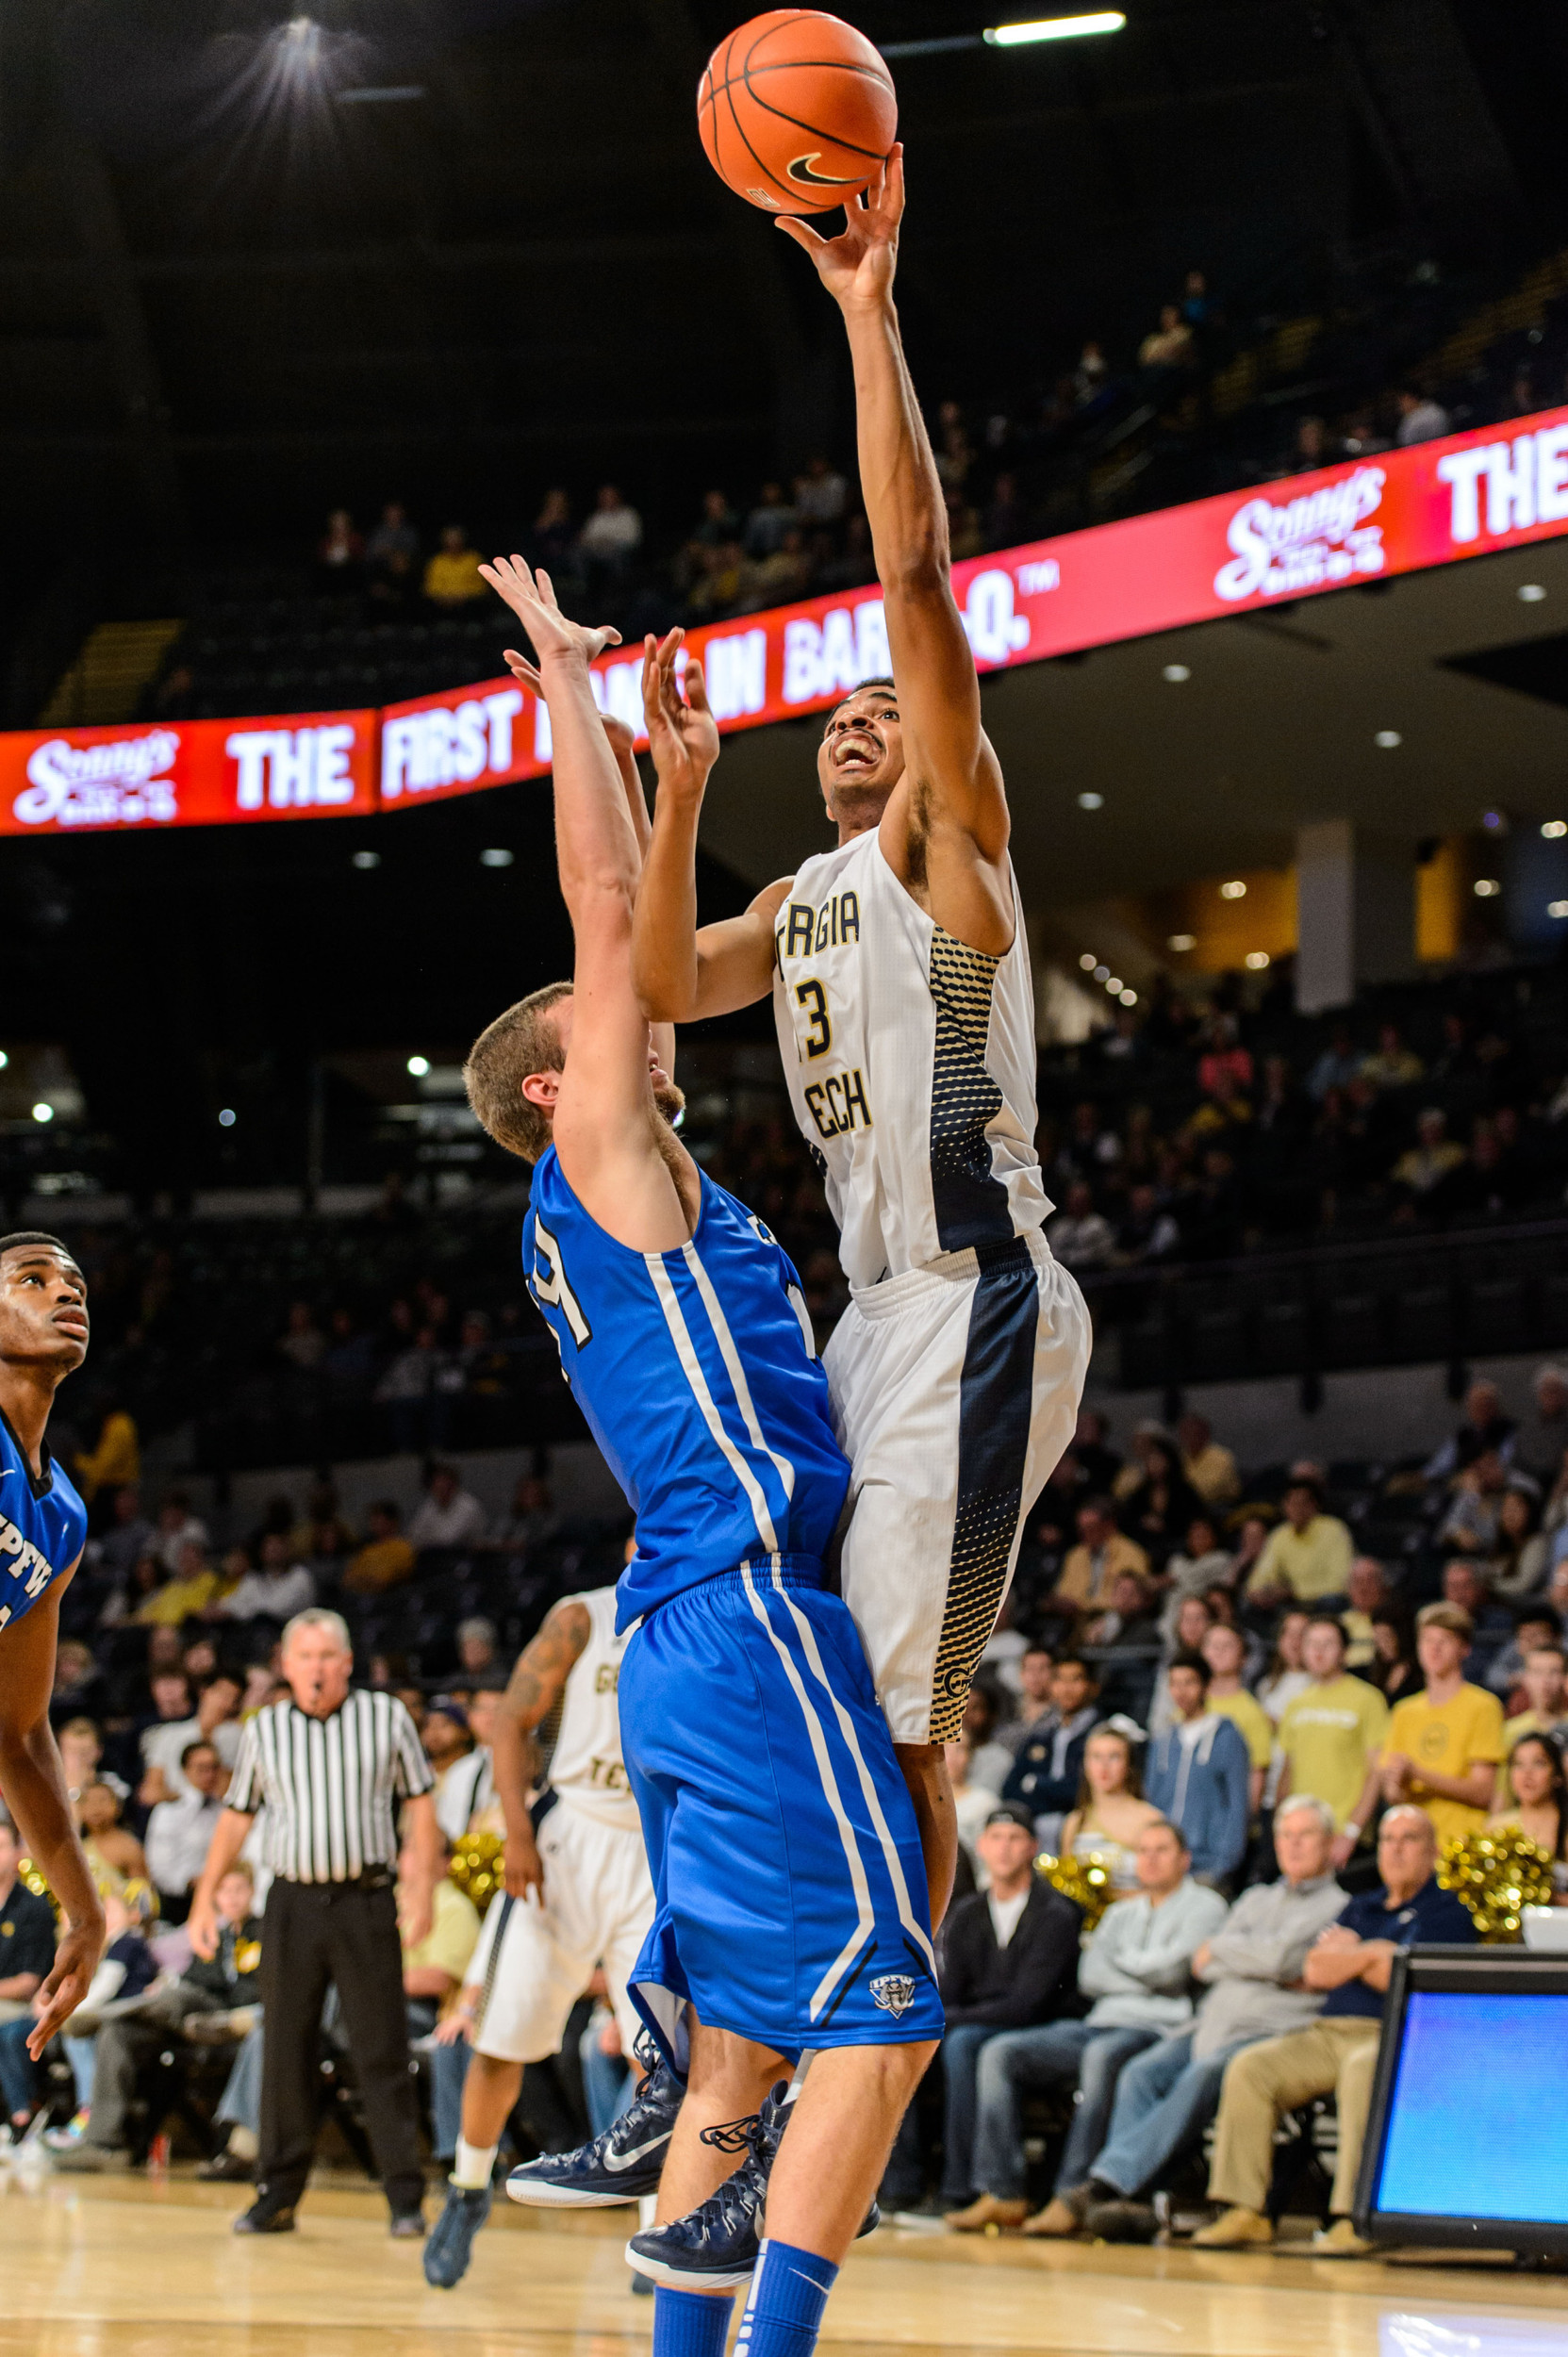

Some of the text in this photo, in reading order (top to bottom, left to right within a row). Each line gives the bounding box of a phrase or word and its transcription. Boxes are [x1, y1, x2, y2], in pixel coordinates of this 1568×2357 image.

[1437, 424, 1568, 543] THE
[226, 725, 355, 809] THE
[381, 689, 523, 799] FIRST
[704, 629, 767, 722] IN
[776, 890, 860, 982] RGIA
[794, 977, 833, 1063] 3
